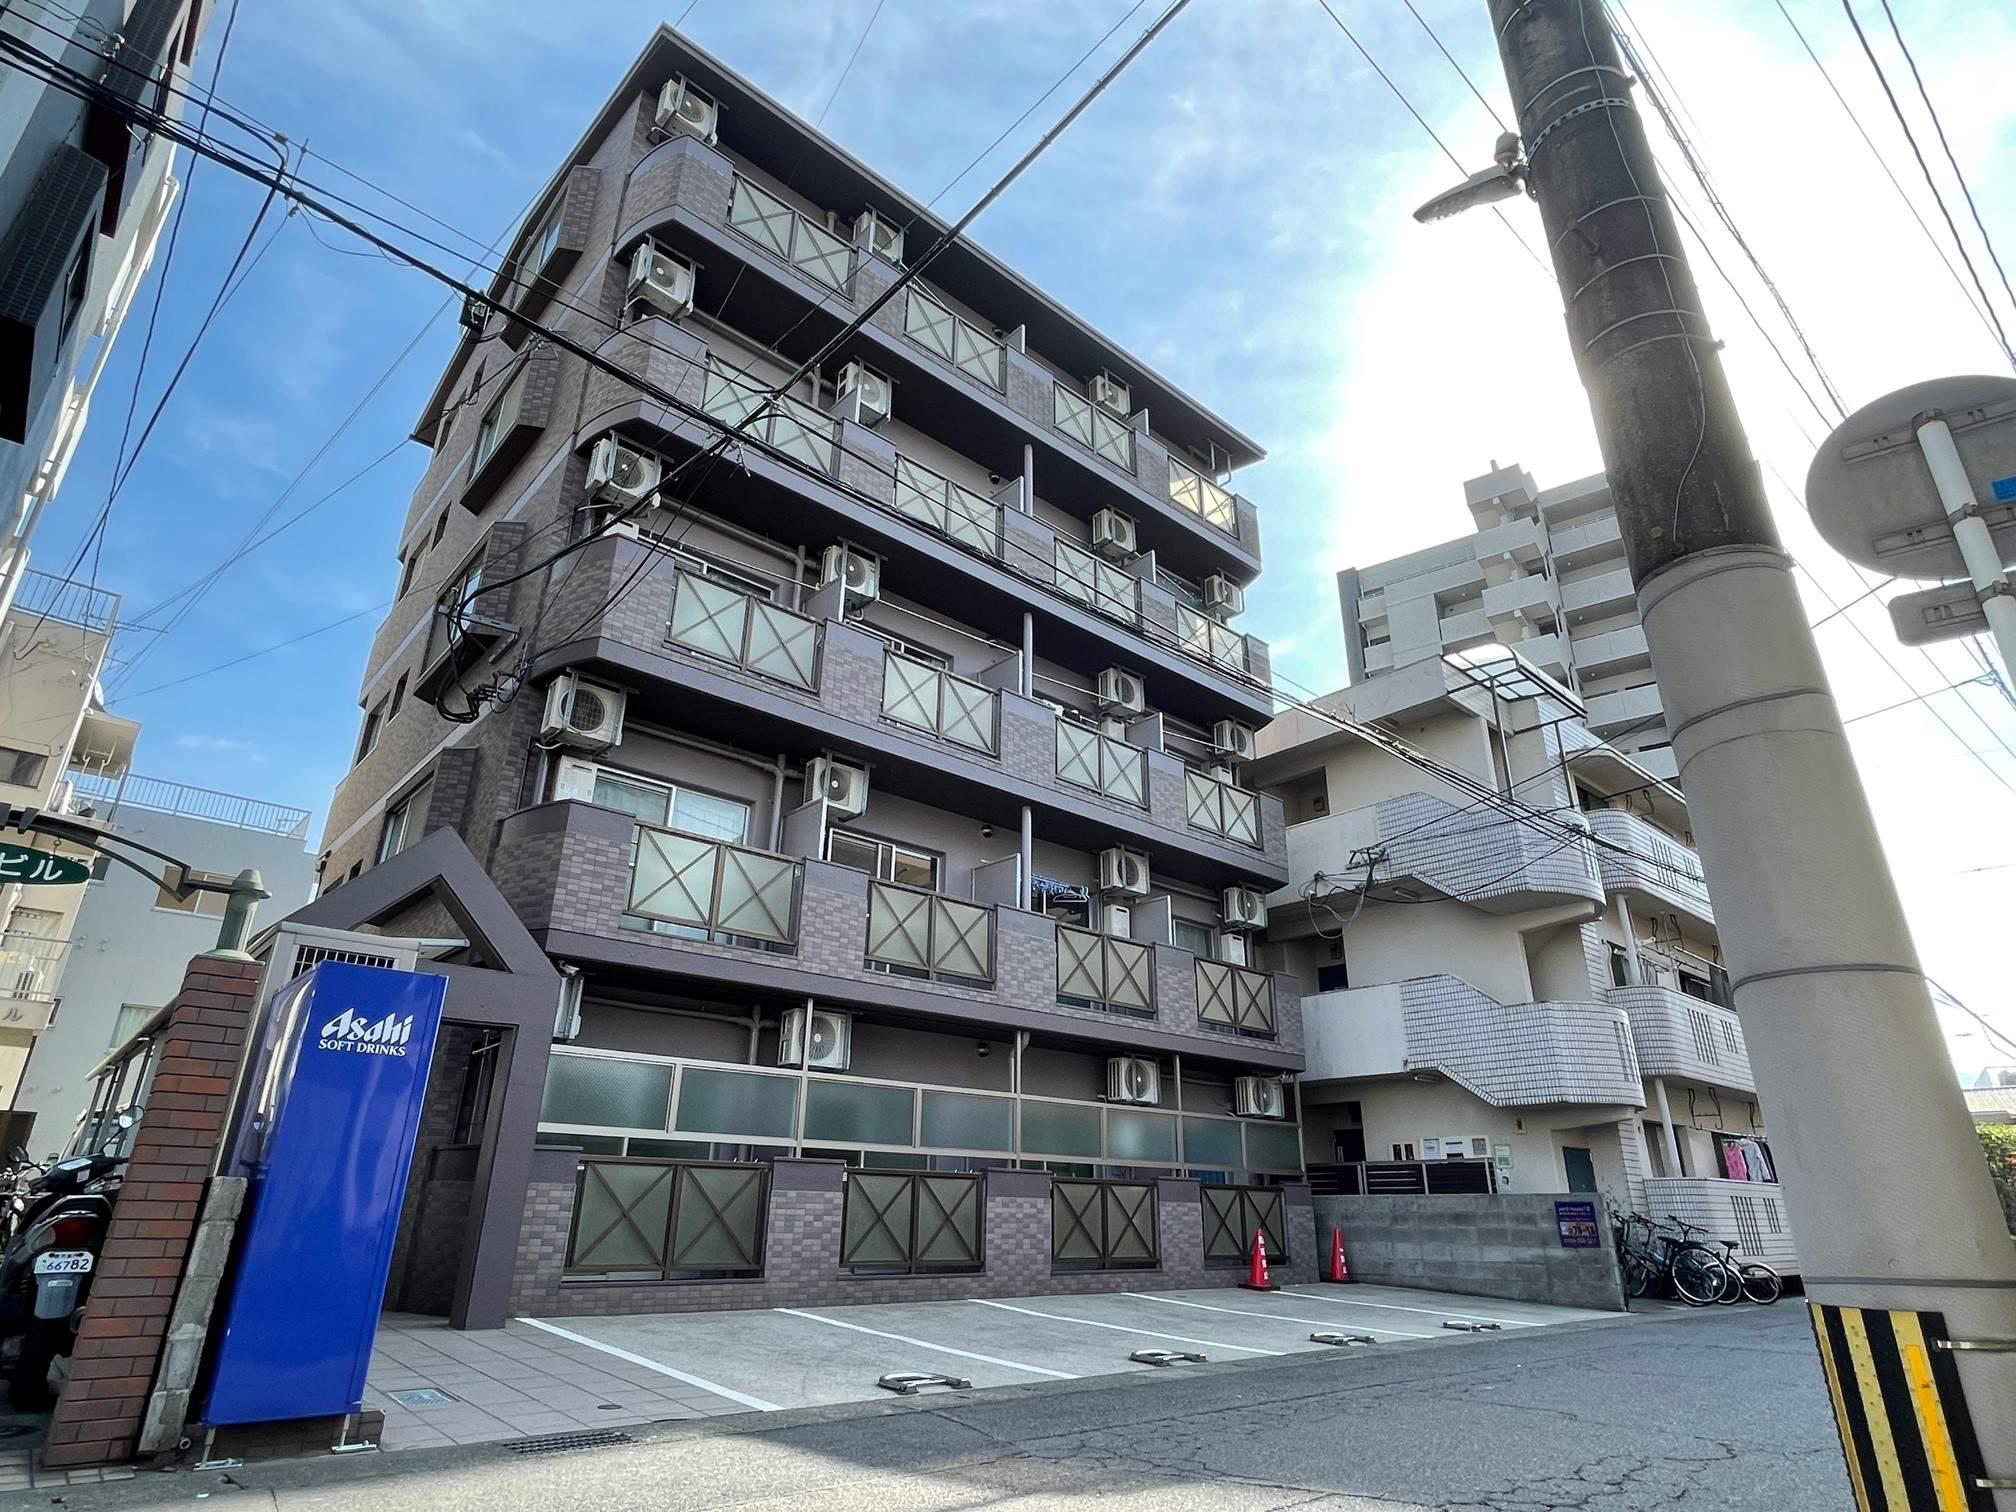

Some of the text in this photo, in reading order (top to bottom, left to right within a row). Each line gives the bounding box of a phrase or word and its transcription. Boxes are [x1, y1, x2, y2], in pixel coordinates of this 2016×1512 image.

[321, 1007, 414, 1046] Asahi
[318, 1038, 407, 1057] SOFT DRINKS
[46, 1258, 90, 1271] 66782
